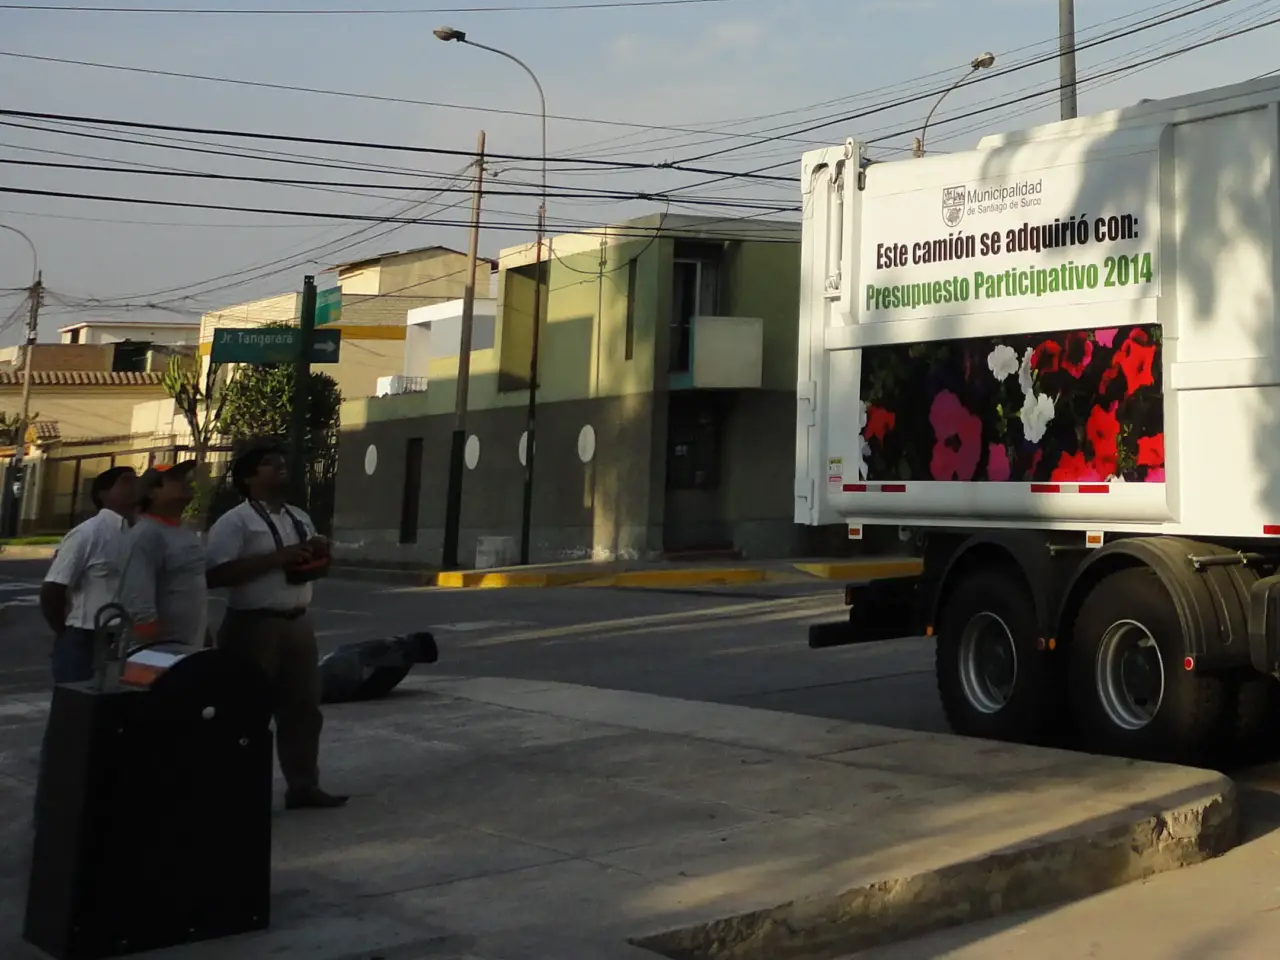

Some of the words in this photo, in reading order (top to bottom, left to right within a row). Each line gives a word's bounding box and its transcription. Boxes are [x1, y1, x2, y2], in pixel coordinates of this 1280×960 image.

[967, 178, 1043, 205] Municipalidad
[966, 206, 976, 216] de
[977, 202, 1008, 214] Santiago
[1009, 200, 1019, 209] de
[1020, 197, 1042, 208] Surco
[876, 242, 909, 270] Este
[912, 230, 976, 265] camión
[980, 231, 1002, 257] se
[1005, 213, 1089, 253] adquirió
[1094, 213, 1139, 243] con:
[866, 276, 970, 311] Presupuesto
[974, 261, 1099, 300] Participativo
[1104, 252, 1153, 287] 2014
[238, 331, 294, 347] Tangarará
